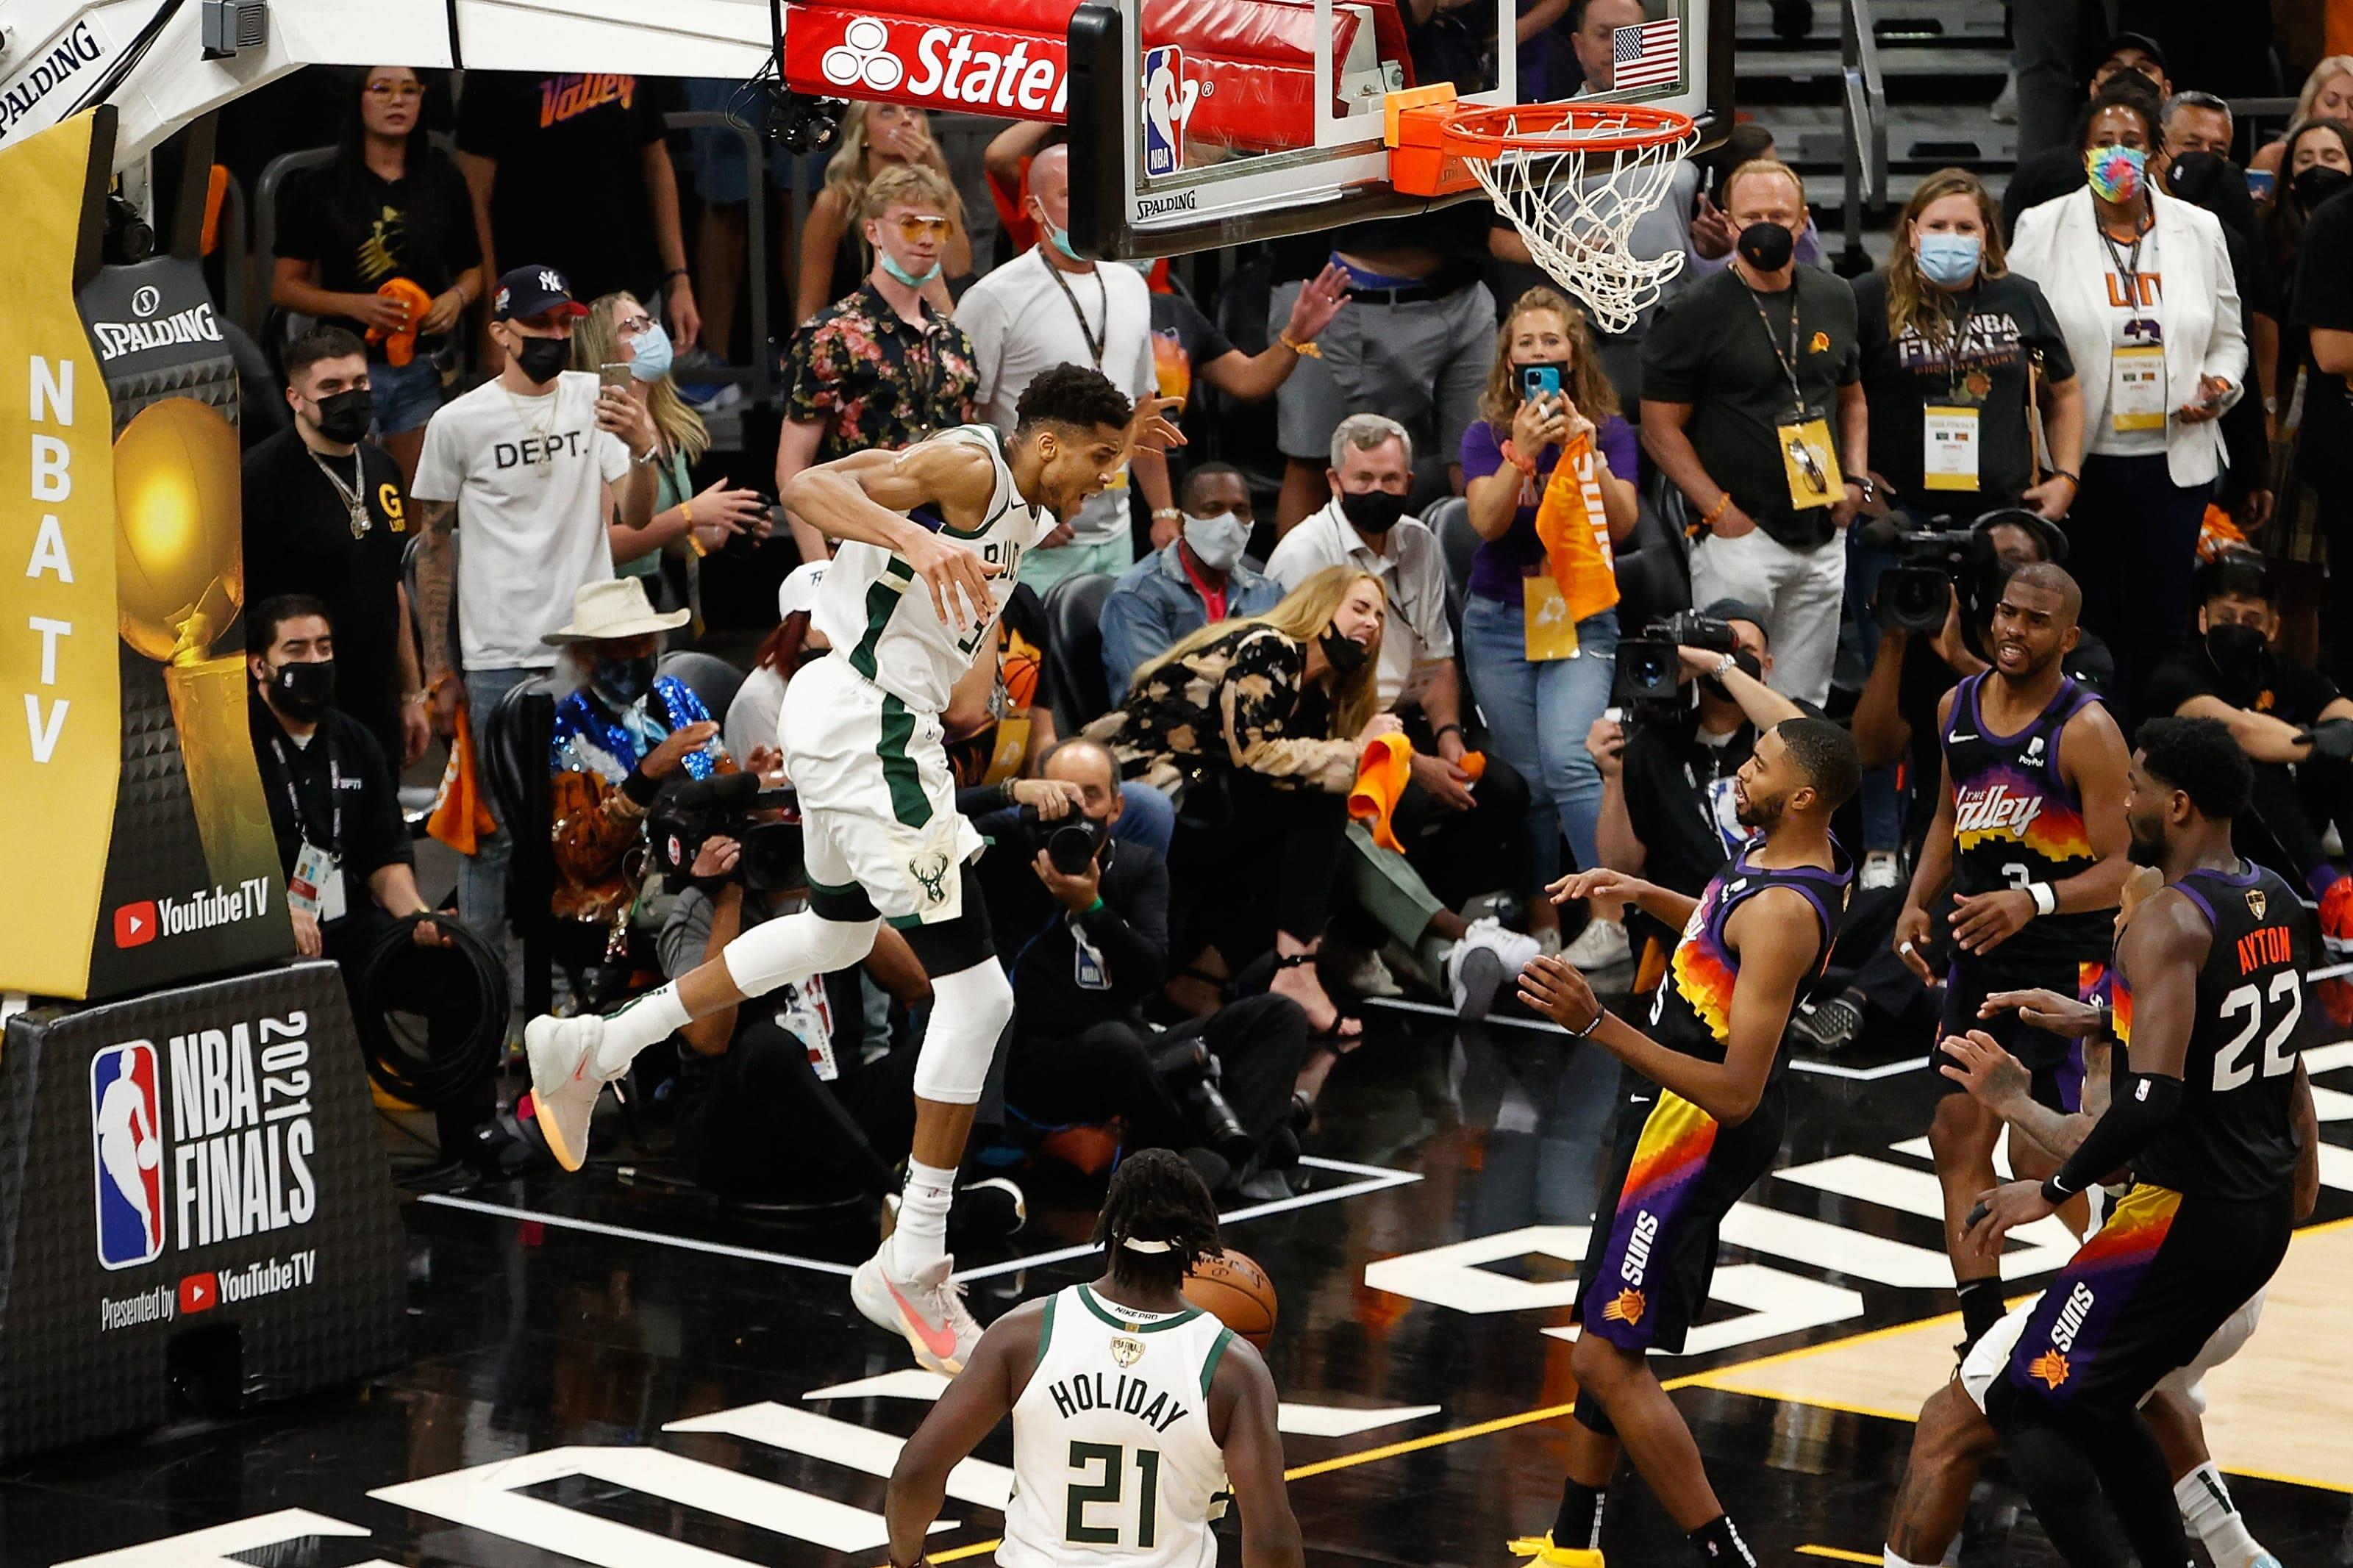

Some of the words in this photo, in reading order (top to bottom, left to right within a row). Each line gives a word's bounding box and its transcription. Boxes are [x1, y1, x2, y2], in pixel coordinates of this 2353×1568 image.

[1151, 147, 1169, 170] NBA
[1137, 190, 1196, 221] SPALDING
[93, 302, 221, 360] SPALDING
[26, 355, 74, 584] NBA
[494, 430, 588, 469] DEPT.
[379, 482, 403, 518] G
[24, 616, 71, 765] TV
[2018, 754, 2044, 767] PayPal
[1966, 791, 1987, 801] THE
[2237, 926, 2291, 976] AYTON
[2212, 968, 2302, 1091] 22
[169, 1022, 259, 1142] NBA
[259, 1011, 313, 1122] 2021
[175, 1117, 315, 1250] FINALS
[1621, 1209, 1659, 1286] SUNS
[101, 1285, 160, 1332] Presented
[161, 1284, 175, 1322] by
[1115, 1306, 1138, 1317] NIKE
[1138, 1312, 1158, 1320] PRO
[2051, 1281, 2095, 1353] SUNS
[1049, 1372, 1189, 1433] HOLIDAY
[1065, 1439, 1162, 1550] 21
